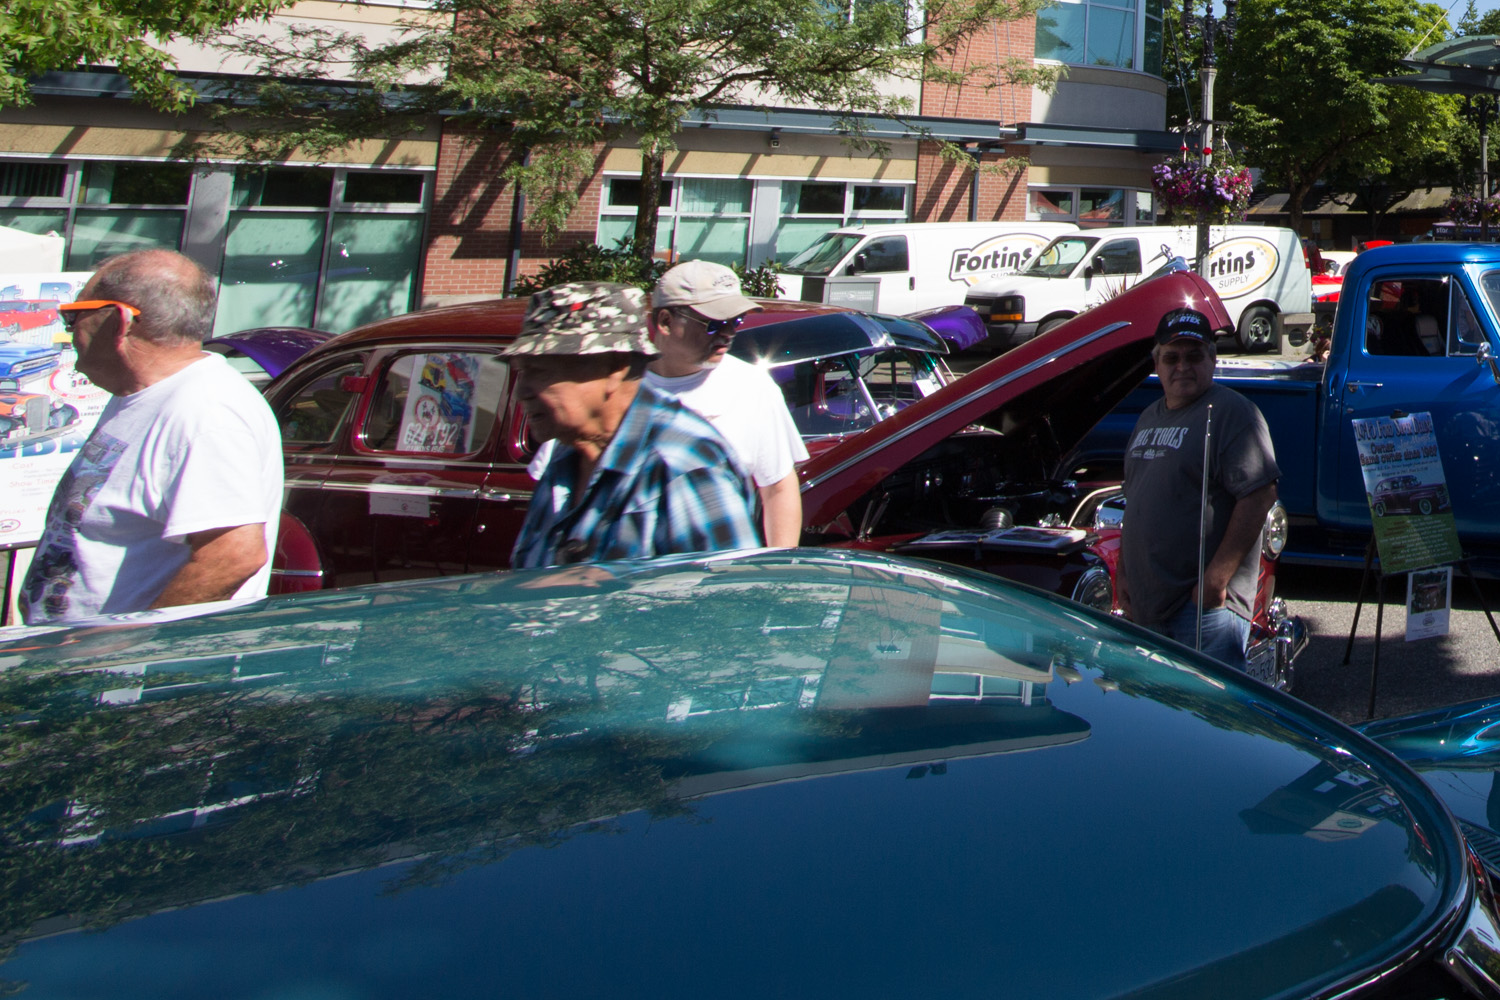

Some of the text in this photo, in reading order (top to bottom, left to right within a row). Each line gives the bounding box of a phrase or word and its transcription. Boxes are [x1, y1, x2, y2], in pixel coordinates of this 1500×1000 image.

[954, 245, 1033, 273] Fortins
[1218, 274, 1250, 289] SUPPLY
[1150, 426, 1190, 450] TOOLS
